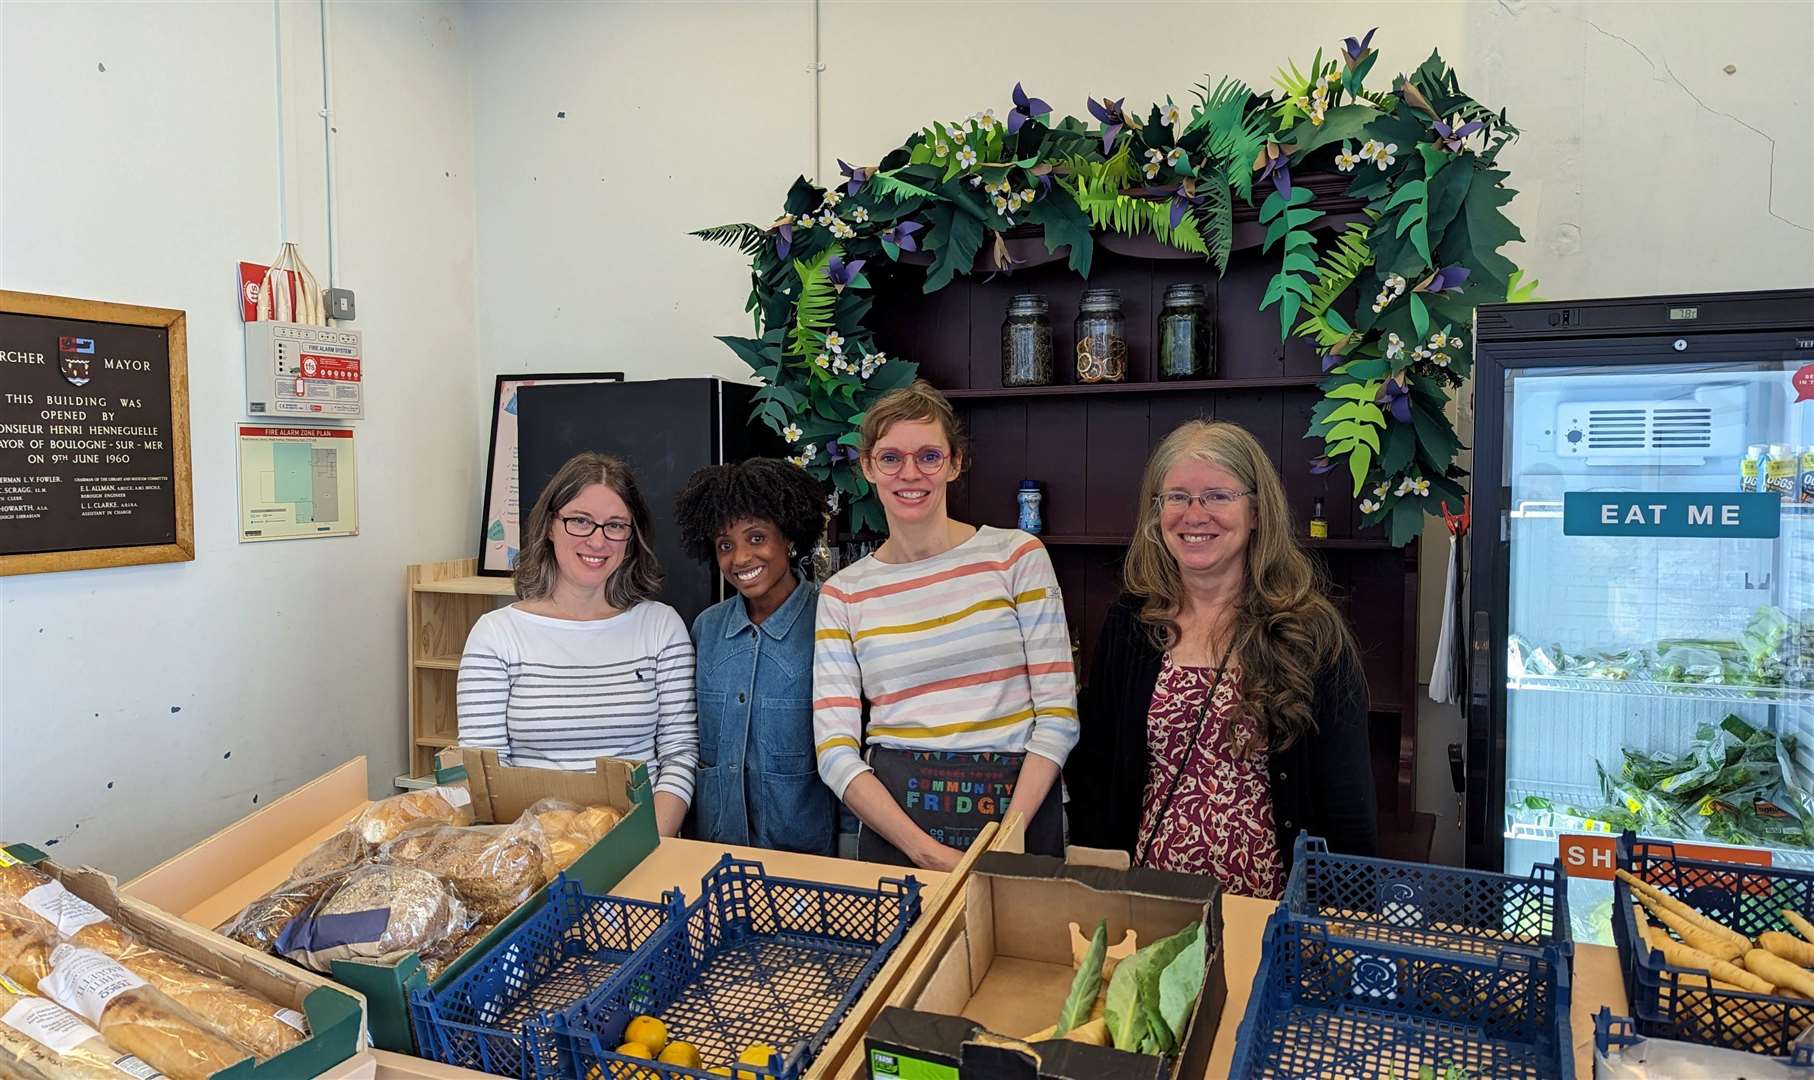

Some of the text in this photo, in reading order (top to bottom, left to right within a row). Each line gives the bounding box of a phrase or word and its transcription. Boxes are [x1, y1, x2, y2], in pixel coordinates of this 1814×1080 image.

[104, 358, 151, 371] MAYOR
[5, 394, 142, 408] THIS BUILDING WAS
[41, 410, 115, 421] OPENED BY
[49, 425, 83, 435] HENRI
[89, 425, 159, 436] HENNEGUELLE
[30, 440, 45, 449] OF
[28, 454, 130, 464] ON 9TH JUNE 1960
[1601, 504, 1741, 525] EAT ME
[908, 778, 1014, 795] COMMUNITY
[906, 791, 1012, 816] FRIDGE
